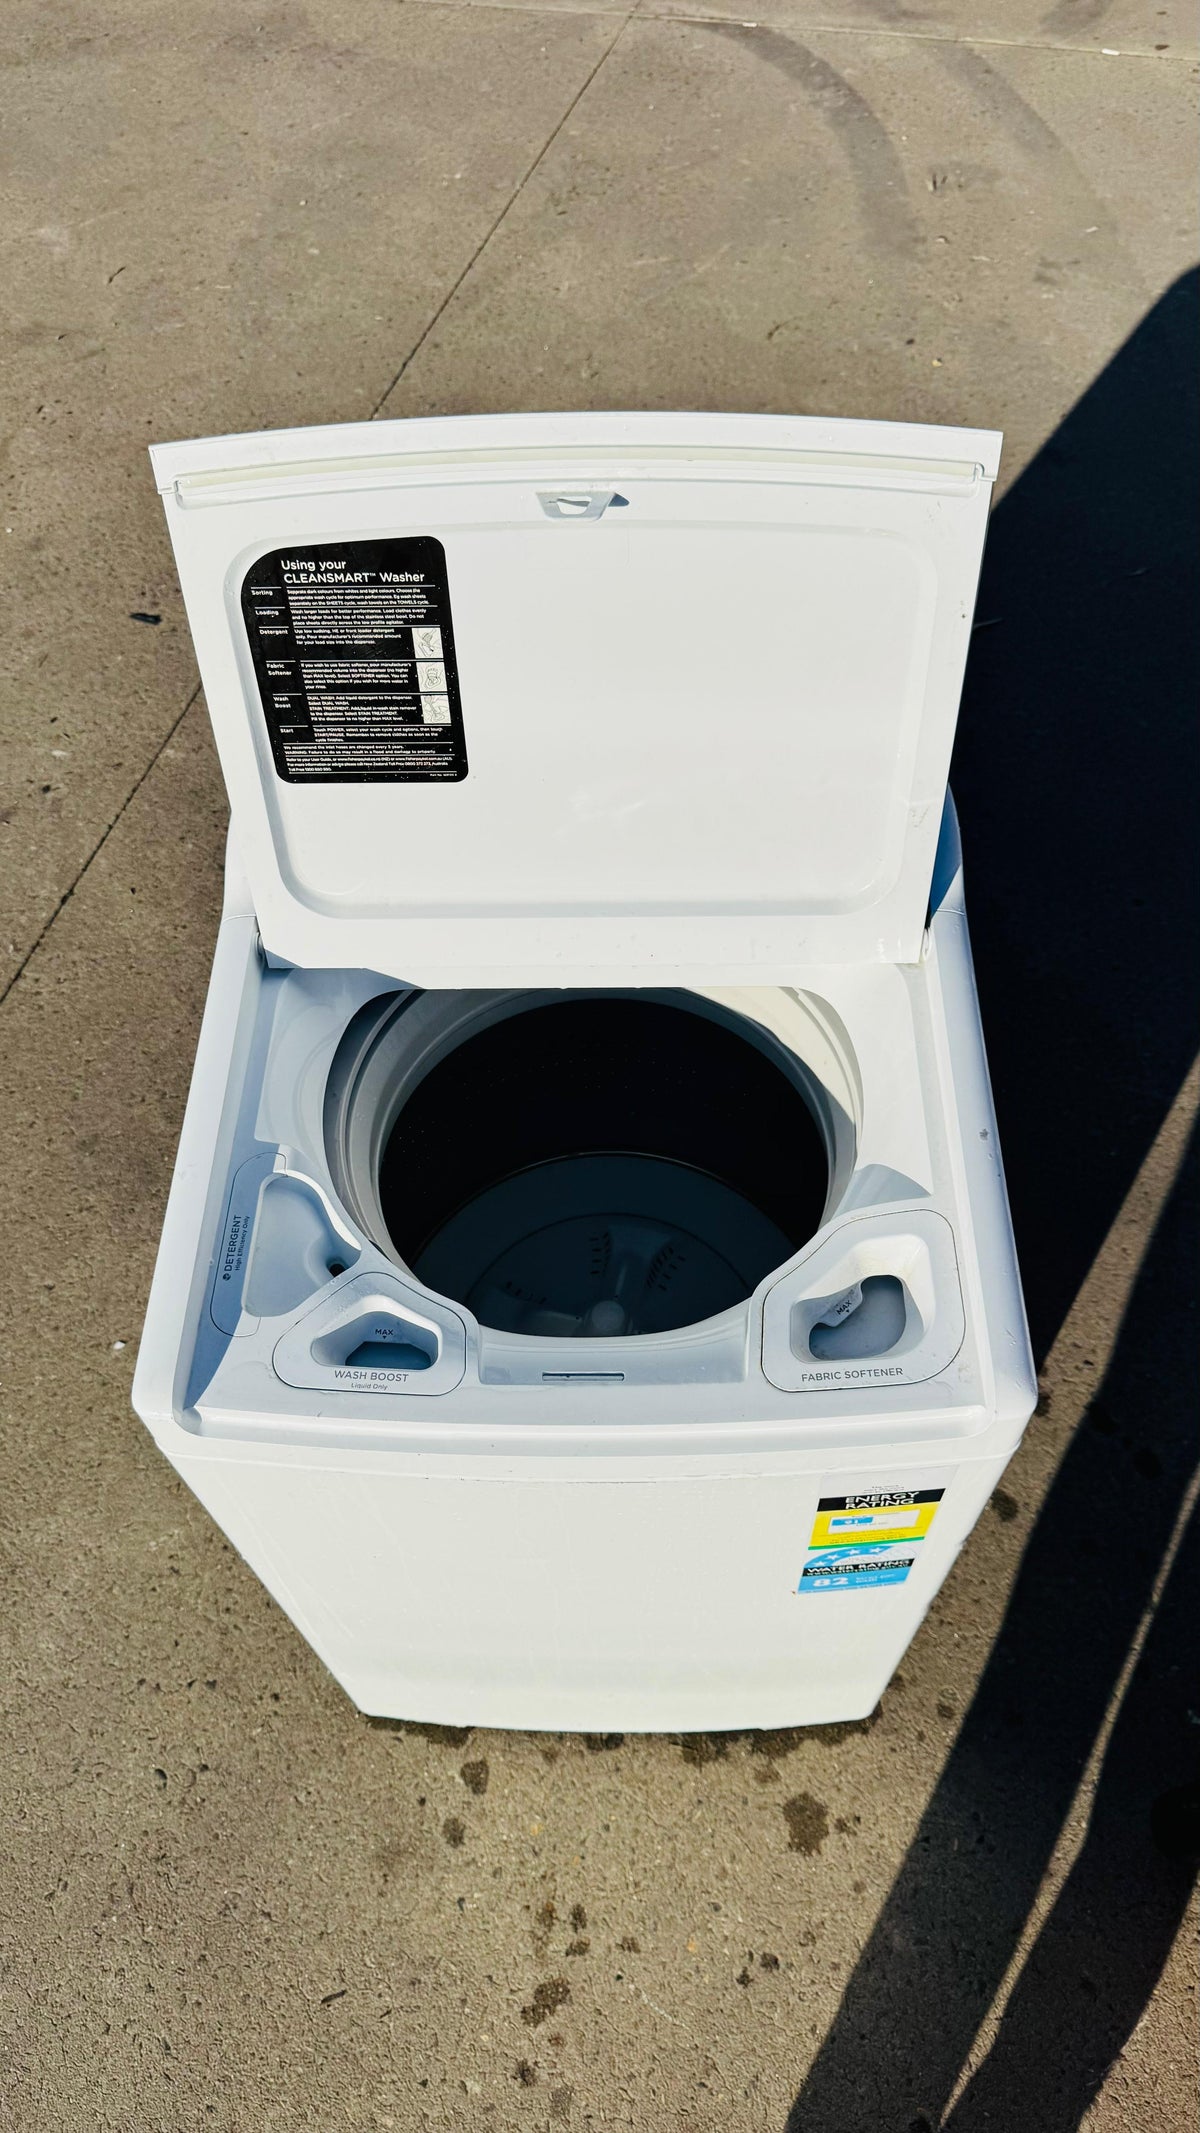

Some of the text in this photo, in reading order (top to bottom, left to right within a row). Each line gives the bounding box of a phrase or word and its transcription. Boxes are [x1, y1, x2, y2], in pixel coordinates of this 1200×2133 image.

[281, 560, 346, 572] Using your
[379, 572, 425, 582] Washer
[224, 1215, 241, 1271] DETERGENT
[836, 1300, 852, 1315] MAX
[334, 1370, 409, 1382] WASH BOOST
[801, 1367, 903, 1382] FABRIC SOFTENER
[845, 1491, 919, 1504] ENERGY
[845, 1499, 914, 1510] RATING
[807, 1564, 854, 1573] WATER
[858, 1560, 910, 1569] RATING
